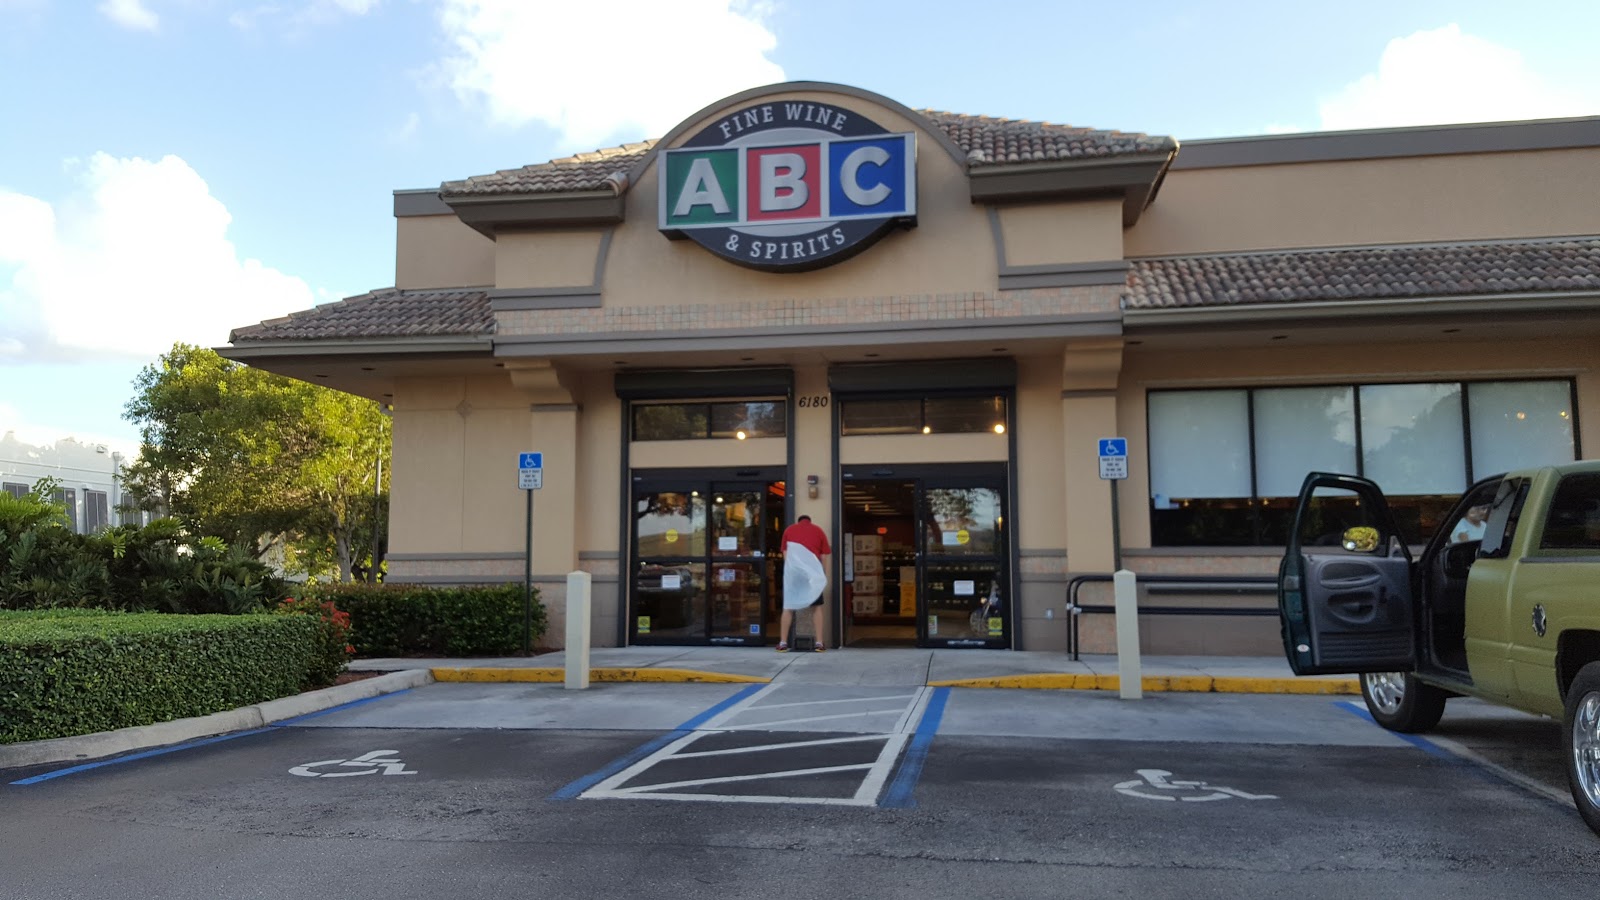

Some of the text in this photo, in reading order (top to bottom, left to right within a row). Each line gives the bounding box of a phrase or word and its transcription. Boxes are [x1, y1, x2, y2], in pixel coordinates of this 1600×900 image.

[719, 103, 847, 139] FINE WINE
[672, 146, 892, 216] ABC
[725, 228, 845, 259] & SPIRITS
[799, 396, 828, 408] 6180
